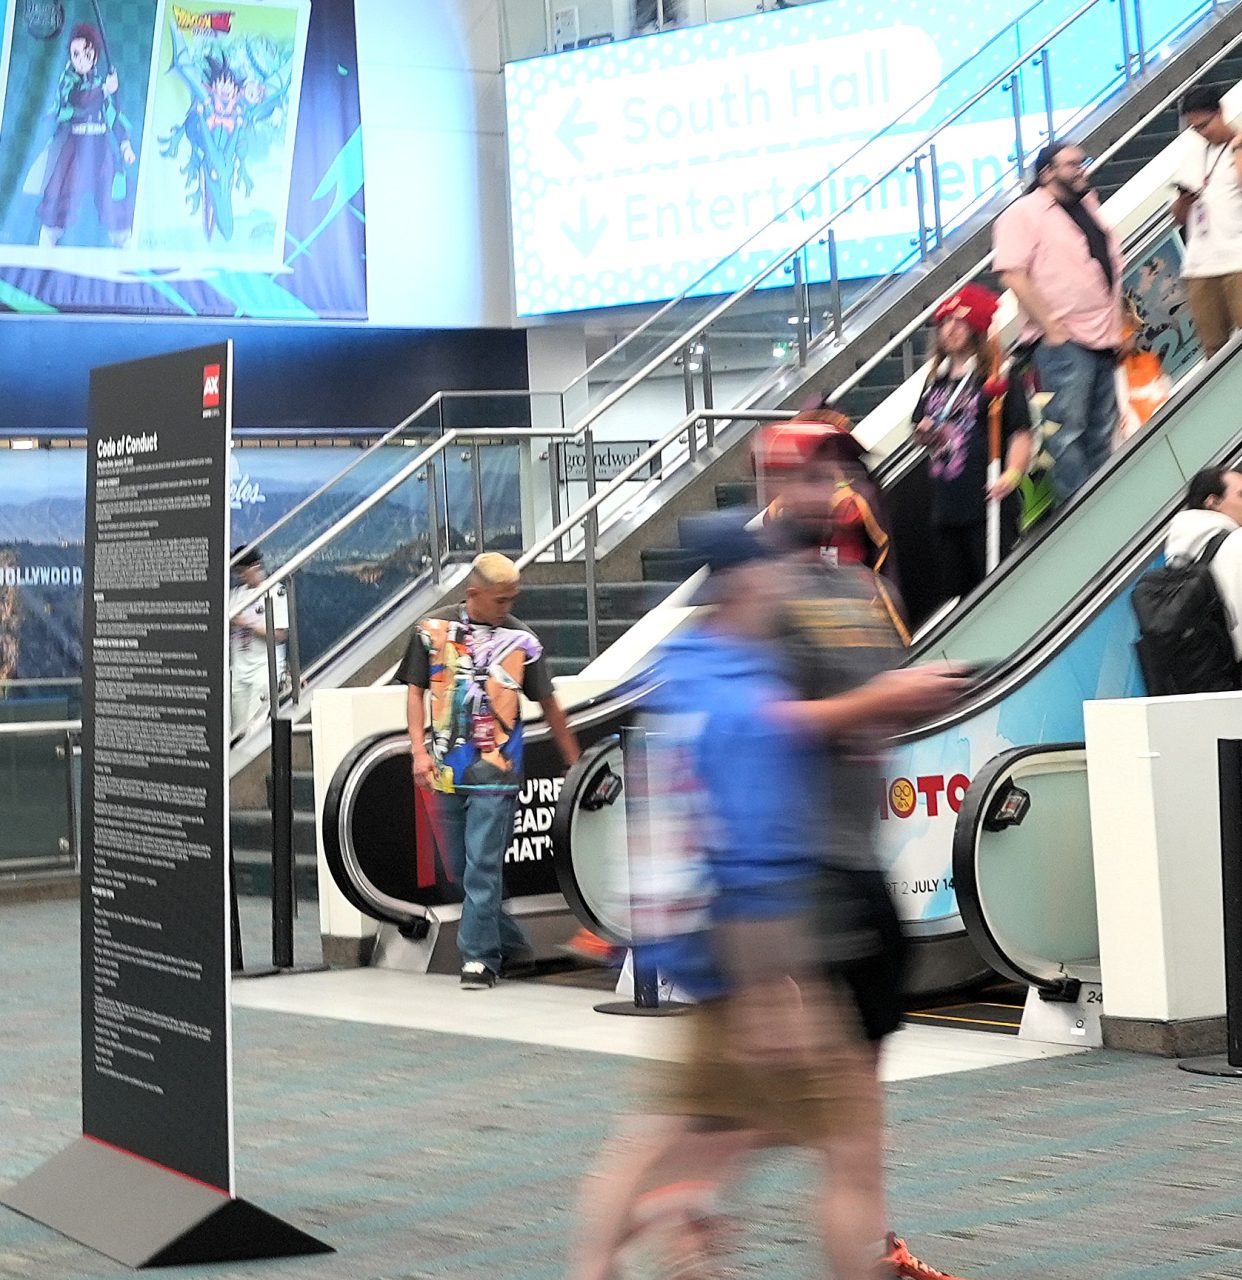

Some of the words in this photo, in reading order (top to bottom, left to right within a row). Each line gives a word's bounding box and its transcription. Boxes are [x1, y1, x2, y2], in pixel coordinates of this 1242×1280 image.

[622, 71, 771, 144] South
[790, 49, 889, 120] Hall
[203, 376, 219, 397] AX
[97, 436, 116, 458] Code
[117, 434, 125, 456] of
[126, 431, 158, 454] Conduct
[513, 806, 556, 833] EAD
[911, 879, 939, 894] JULY
